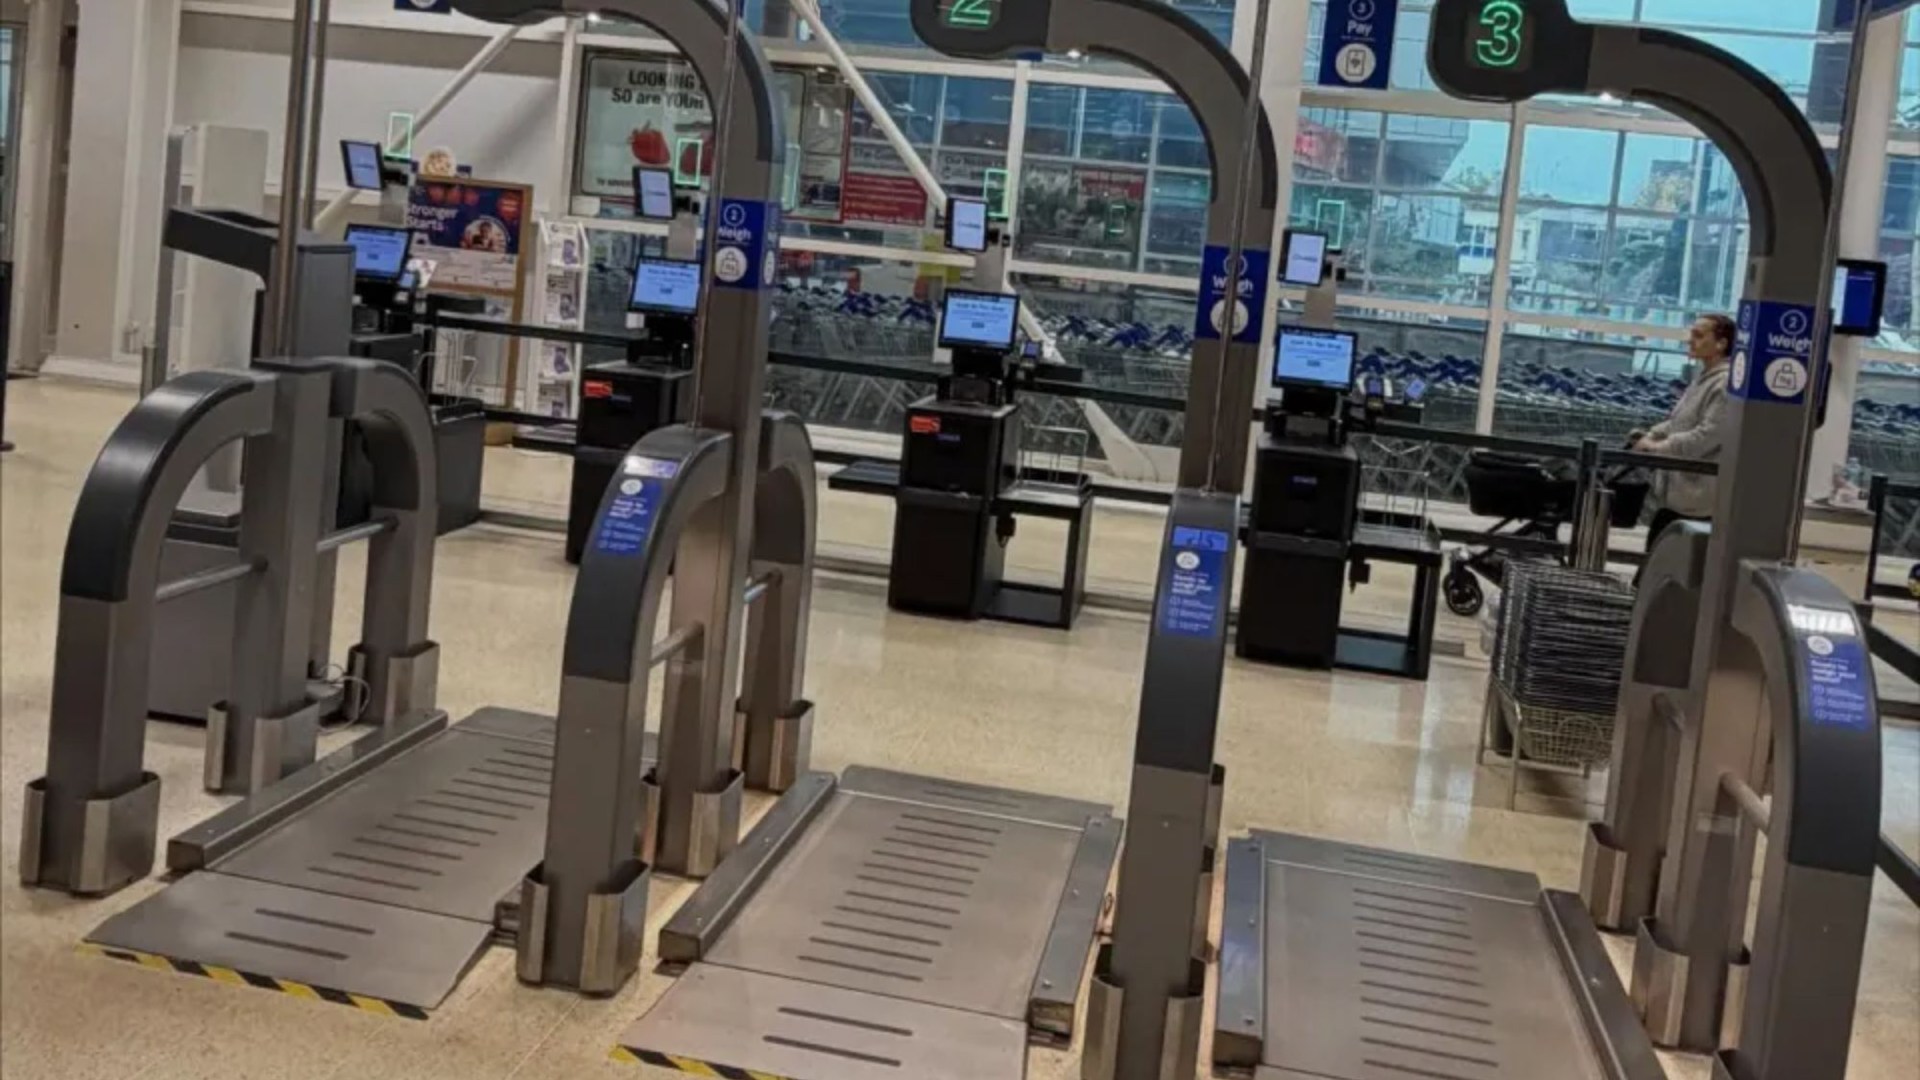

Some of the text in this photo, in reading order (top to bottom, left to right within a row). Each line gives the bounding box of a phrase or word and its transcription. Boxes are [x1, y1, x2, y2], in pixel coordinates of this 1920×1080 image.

[1348, 20, 1373, 37] Pay
[1477, 1, 1522, 66] 3
[628, 69, 695, 90] LOOKING
